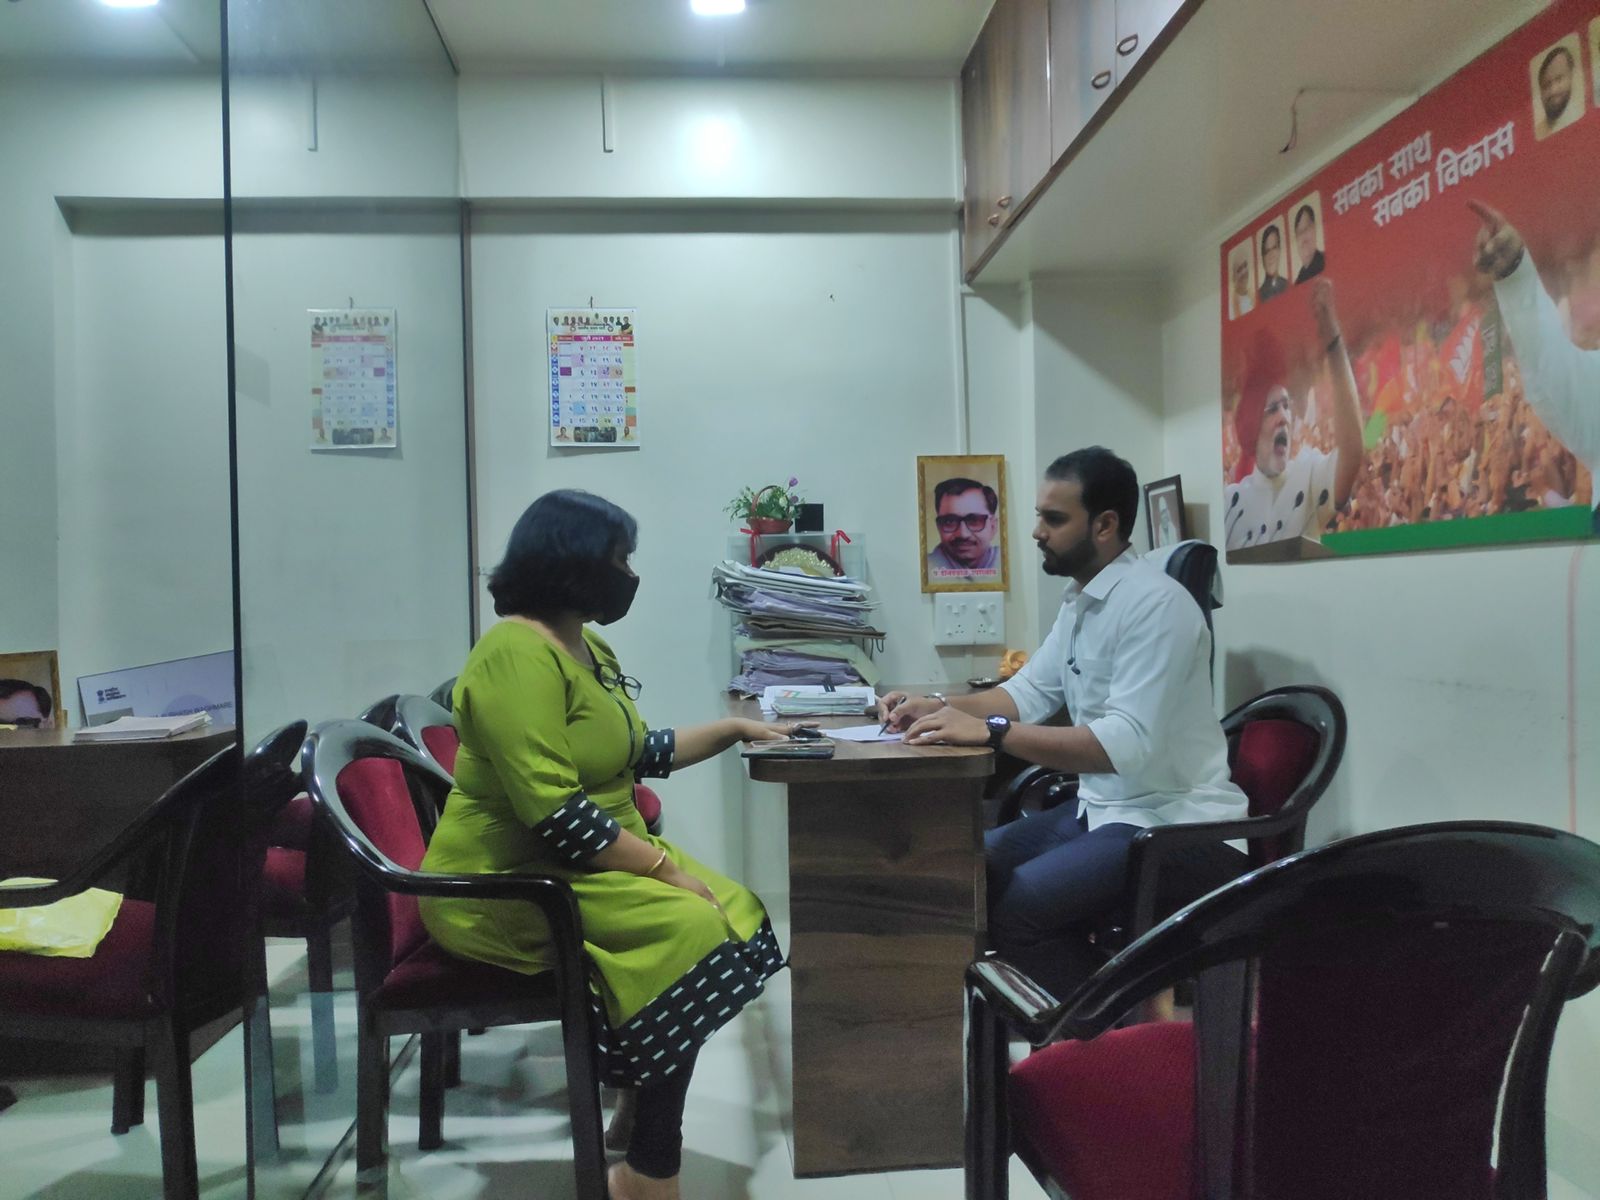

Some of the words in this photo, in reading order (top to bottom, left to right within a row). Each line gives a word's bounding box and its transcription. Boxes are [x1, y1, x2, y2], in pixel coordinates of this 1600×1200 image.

[1333, 163, 1384, 214] सबका
[1388, 131, 1432, 179] साथ
[1373, 171, 1431, 227] सबका
[1435, 121, 1516, 193] विकास
